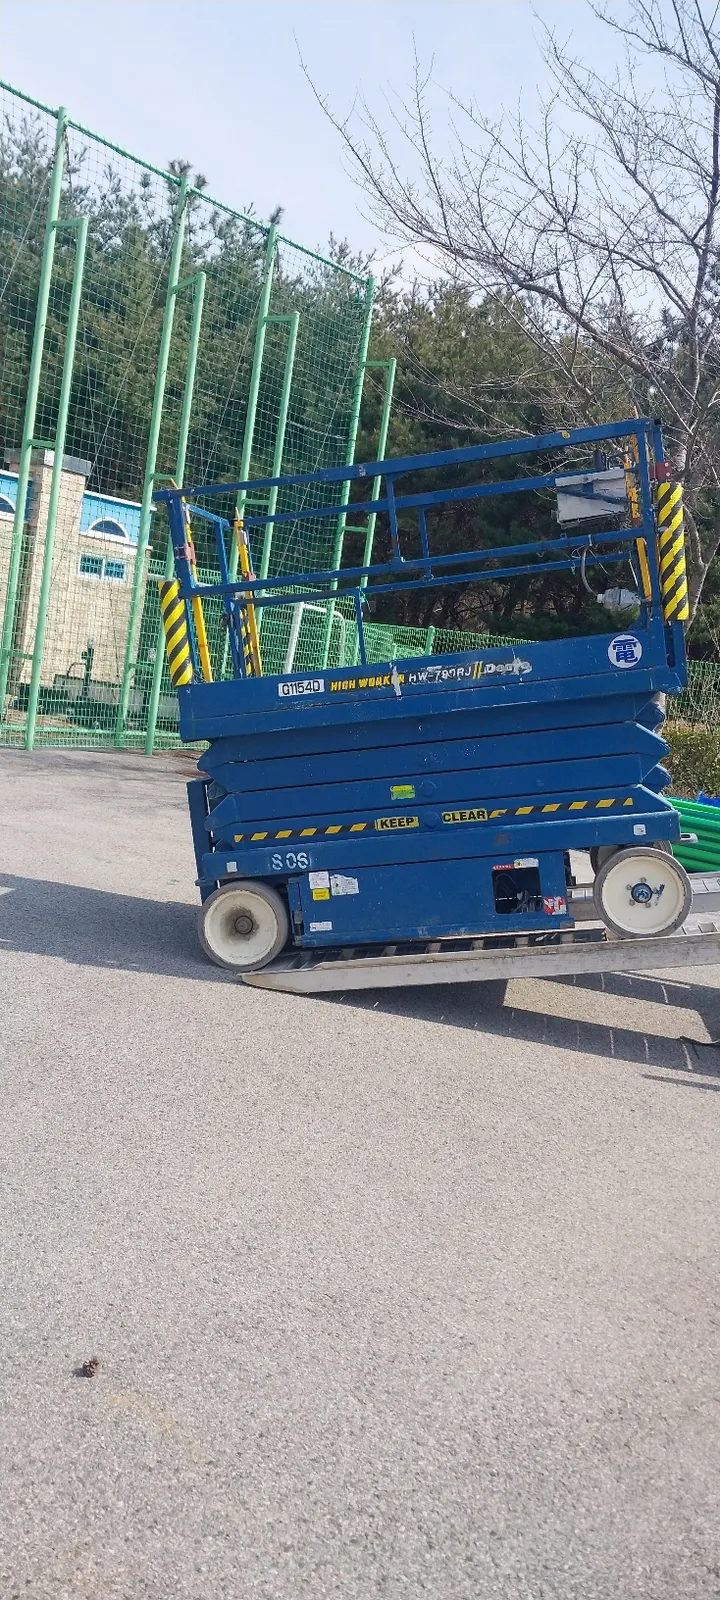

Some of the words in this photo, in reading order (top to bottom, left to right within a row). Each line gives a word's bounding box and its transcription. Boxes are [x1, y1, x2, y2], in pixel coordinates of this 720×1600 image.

[612, 638, 639, 664] 電
[282, 680, 321, 696] G1154D
[330, 679, 356, 691] HIGH
[380, 817, 416, 829] KEEP
[442, 809, 487, 823] CLEAR
